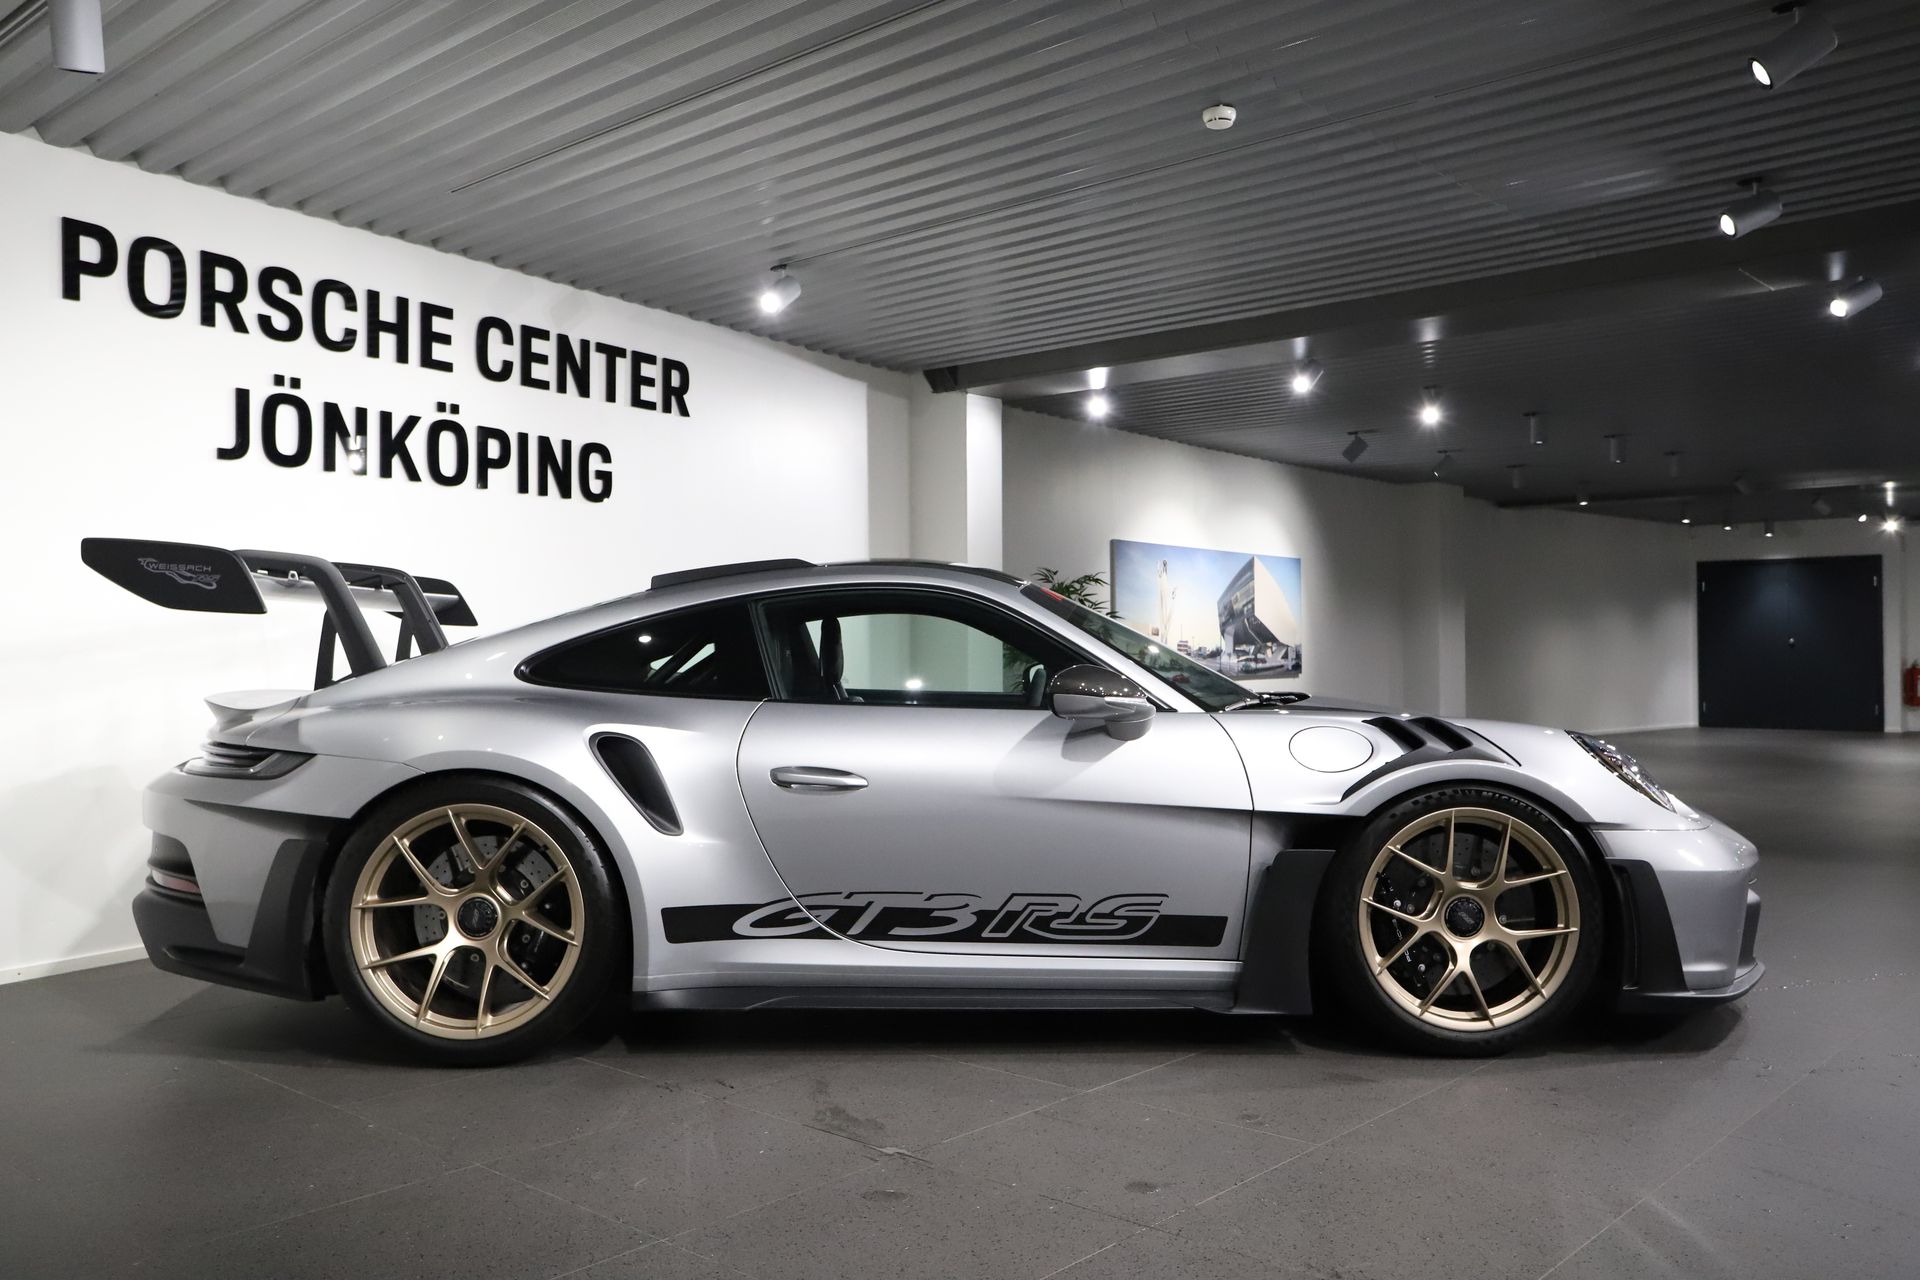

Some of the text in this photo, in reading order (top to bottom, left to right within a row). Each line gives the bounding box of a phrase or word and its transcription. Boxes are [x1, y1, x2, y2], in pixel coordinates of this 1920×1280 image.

[61, 216, 690, 418] PORSCHE CENTER
[217, 374, 613, 503] JÖNKÖPING
[148, 562, 212, 573] WEISSACH
[732, 891, 1169, 939] GT3 RS
